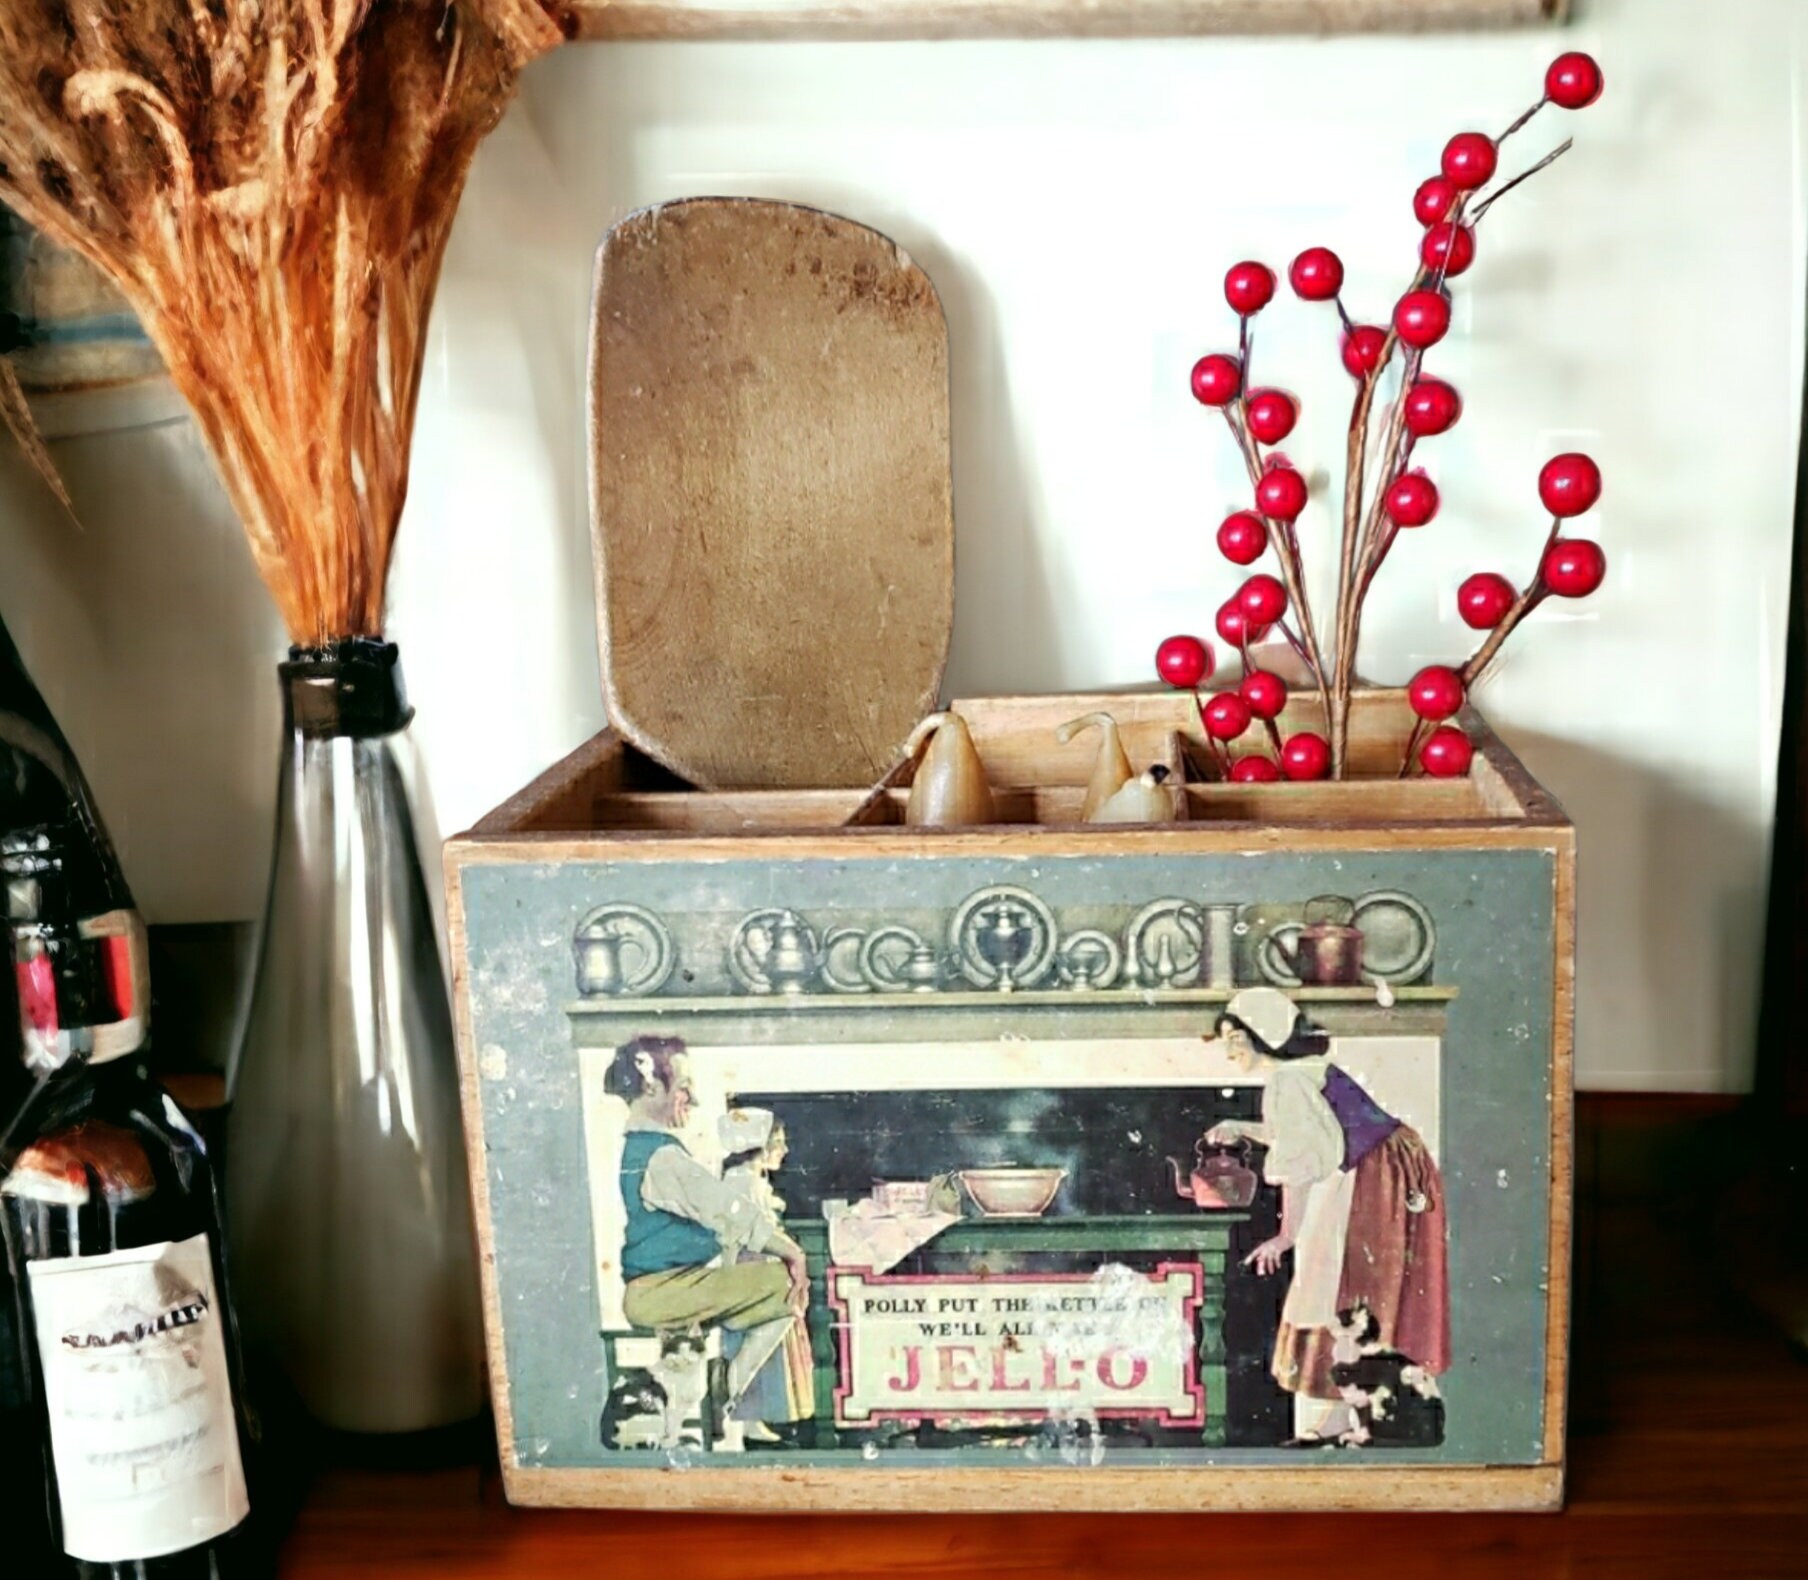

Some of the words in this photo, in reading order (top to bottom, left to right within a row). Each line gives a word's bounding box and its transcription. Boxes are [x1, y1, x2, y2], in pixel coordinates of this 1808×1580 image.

[863, 1298, 927, 1314] POLLY
[937, 1298, 979, 1314] PUT
[992, 1297, 1034, 1313] THE
[918, 1322, 987, 1337] WE'LL
[887, 1343, 1149, 1392] JELL-O
